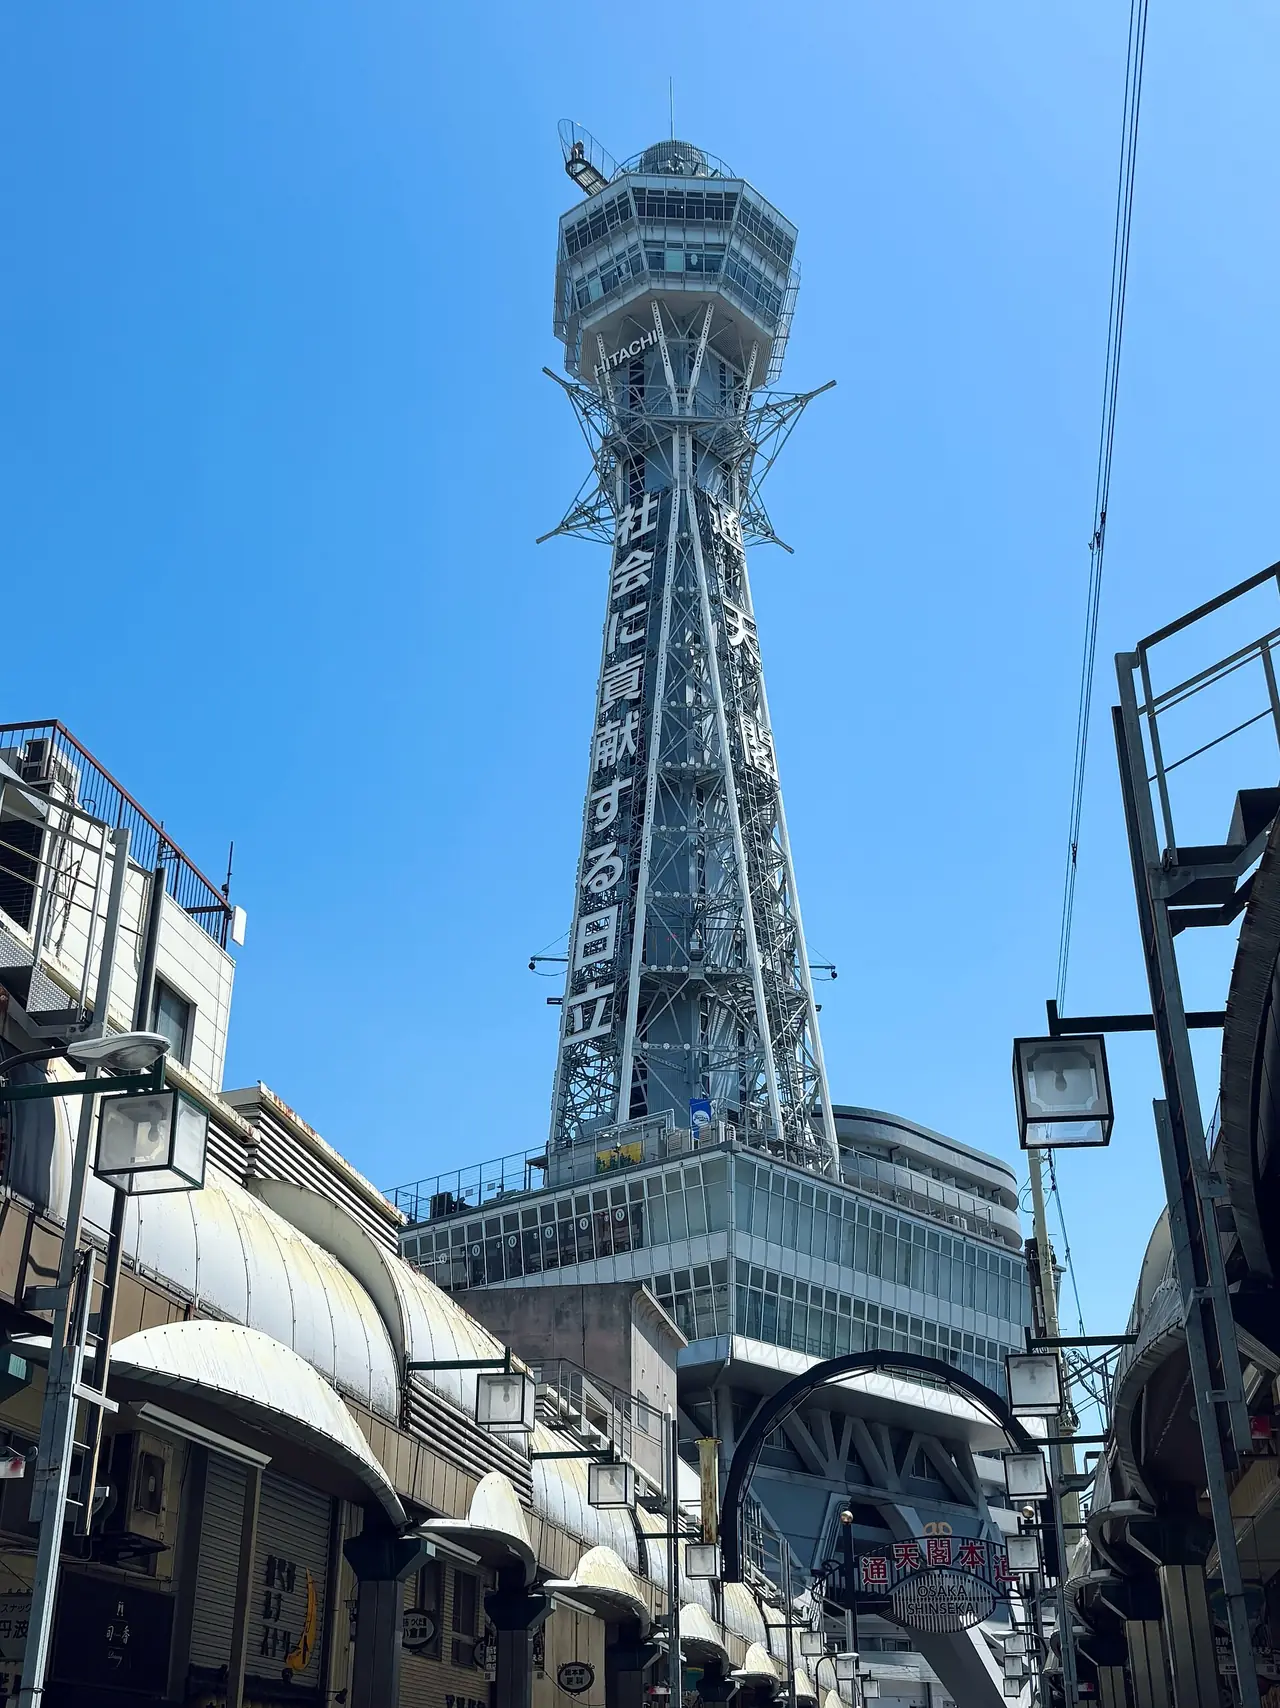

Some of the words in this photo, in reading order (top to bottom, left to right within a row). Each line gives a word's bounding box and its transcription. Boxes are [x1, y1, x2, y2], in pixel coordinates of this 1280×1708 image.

[593, 329, 660, 377] HITACHI
[706, 491, 780, 783] 通天閣
[563, 493, 658, 1048] 社会に貢献する日立
[917, 1585, 967, 1597] OSAKA
[1, 1603, 32, 1613] スナック
[907, 1602, 979, 1615] SHINSEKAI
